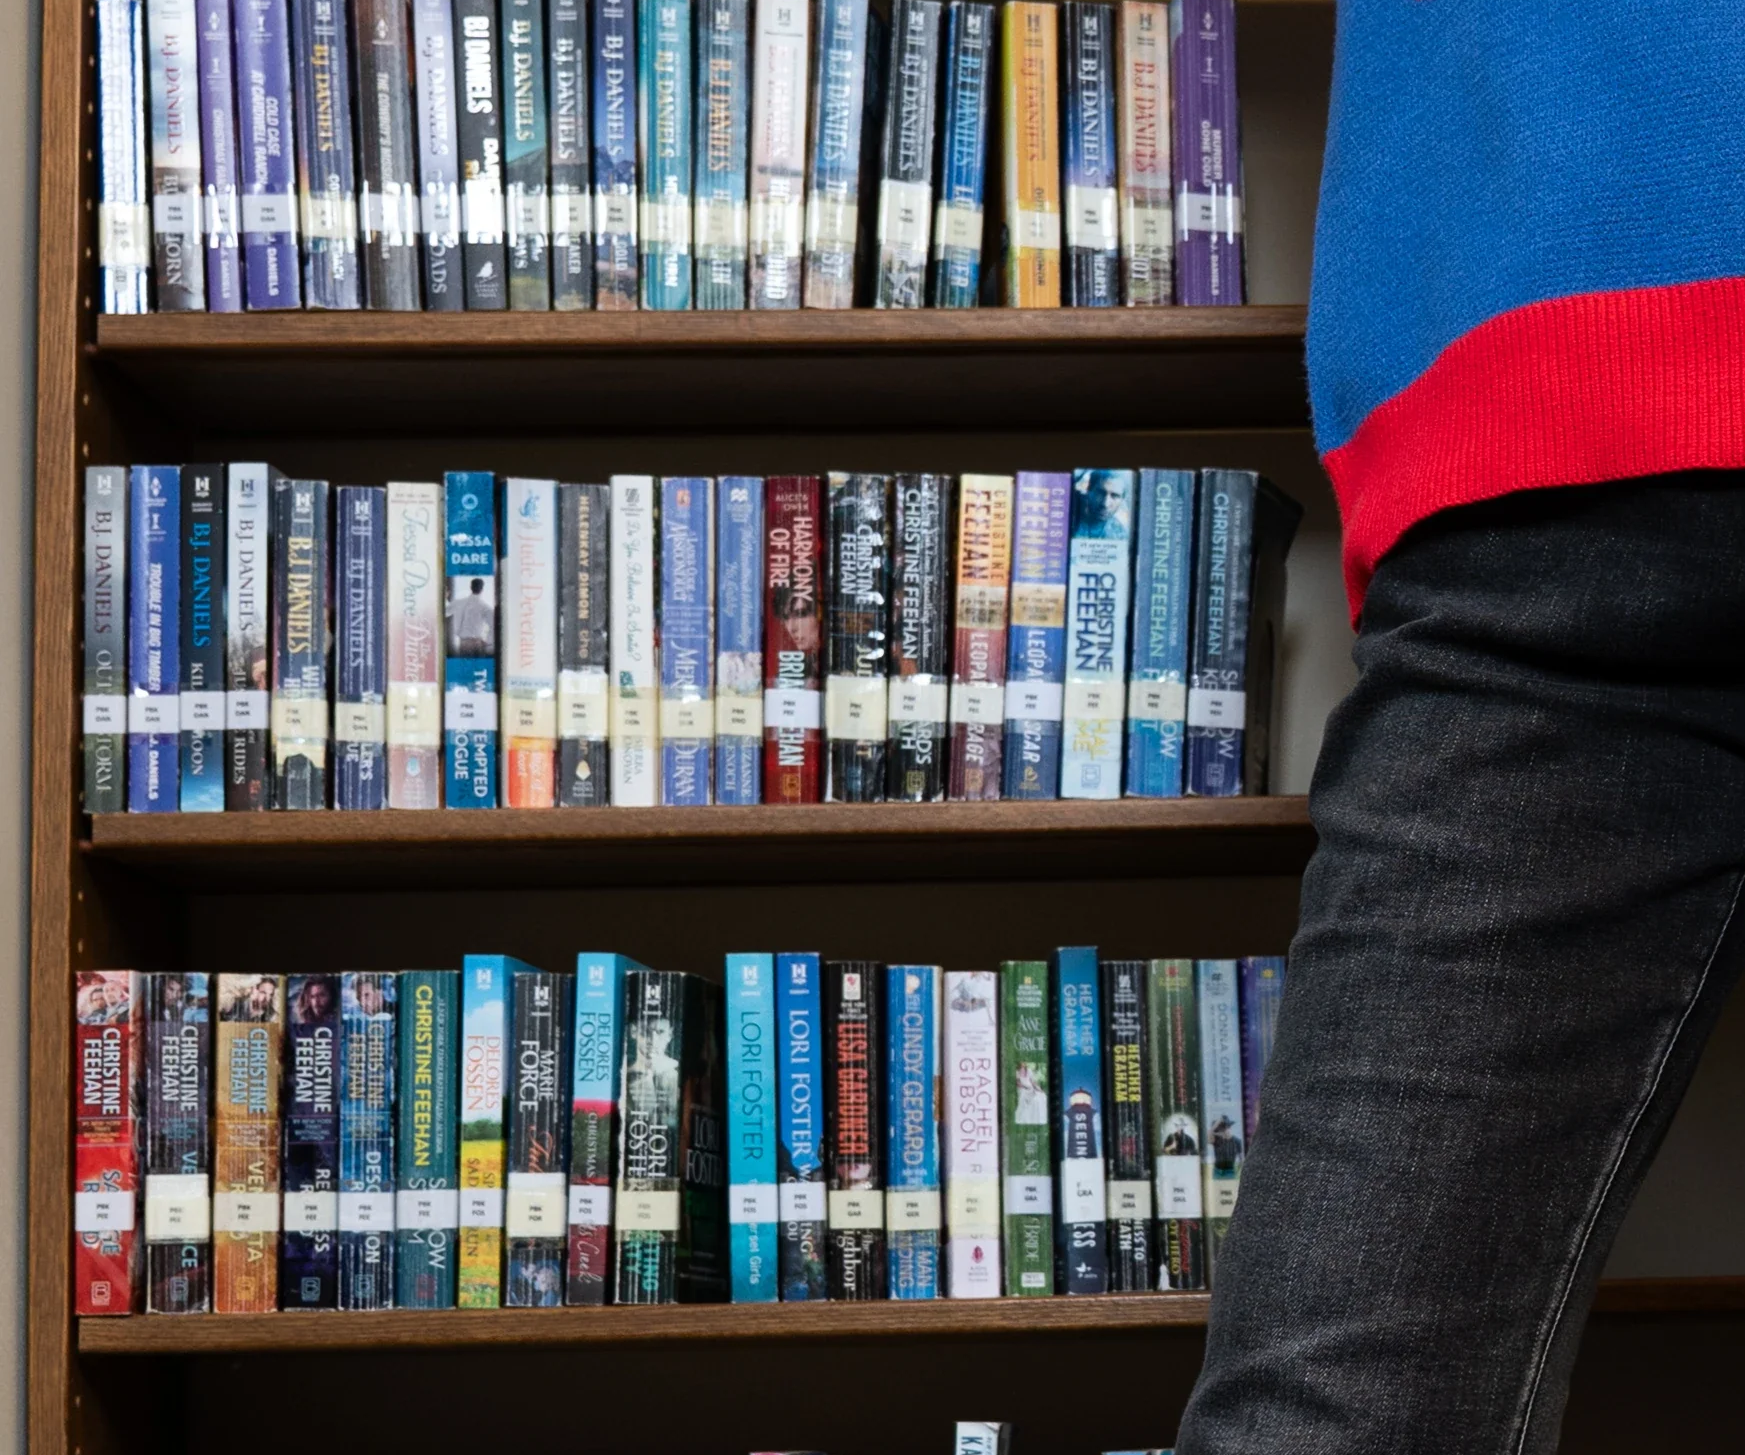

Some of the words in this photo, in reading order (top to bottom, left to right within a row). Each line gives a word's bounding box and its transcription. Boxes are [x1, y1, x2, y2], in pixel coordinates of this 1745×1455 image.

[264, 94, 281, 126] COLD
[606, 67, 627, 157] DANIELS
[1201, 119, 1213, 154] GONE
[266, 127, 282, 157] CASE
[1211, 129, 1223, 181] MURDER
[1202, 157, 1214, 188] COLD
[1093, 255, 1107, 299] HEARTS
[402, 507, 431, 564] Tessa
[519, 534, 541, 578] Jude
[770, 528, 791, 550] OF
[791, 516, 815, 602] HARMONY
[148, 562, 164, 610] TROUBLE
[402, 561, 431, 617] Dare
[770, 554, 792, 589] FIRE
[148, 613, 162, 624] IN
[192, 557, 213, 647] DANIELS
[518, 583, 546, 671] Deveraux
[1074, 571, 1099, 671] FEEHAN
[1097, 571, 1117, 672] CHRISTINE
[148, 627, 162, 648] BIG
[148, 650, 164, 692] TIMBER
[232, 736, 247, 785] RIDES
[578, 1011, 597, 1084] FOSSEN
[596, 1012, 612, 1082] DELORES
[740, 1010, 763, 1064] LORI
[837, 1022, 870, 1062] LISA
[903, 1011, 926, 1074] CINDY
[82, 1037, 101, 1106] FEEHAN
[102, 1027, 122, 1115] CHRISTINE
[517, 1039, 541, 1113] FORCE
[538, 1049, 556, 1101] MARIE
[741, 1069, 764, 1160] FOSTER
[837, 1066, 870, 1155] GARDNER
[903, 1080, 925, 1165] GERARD
